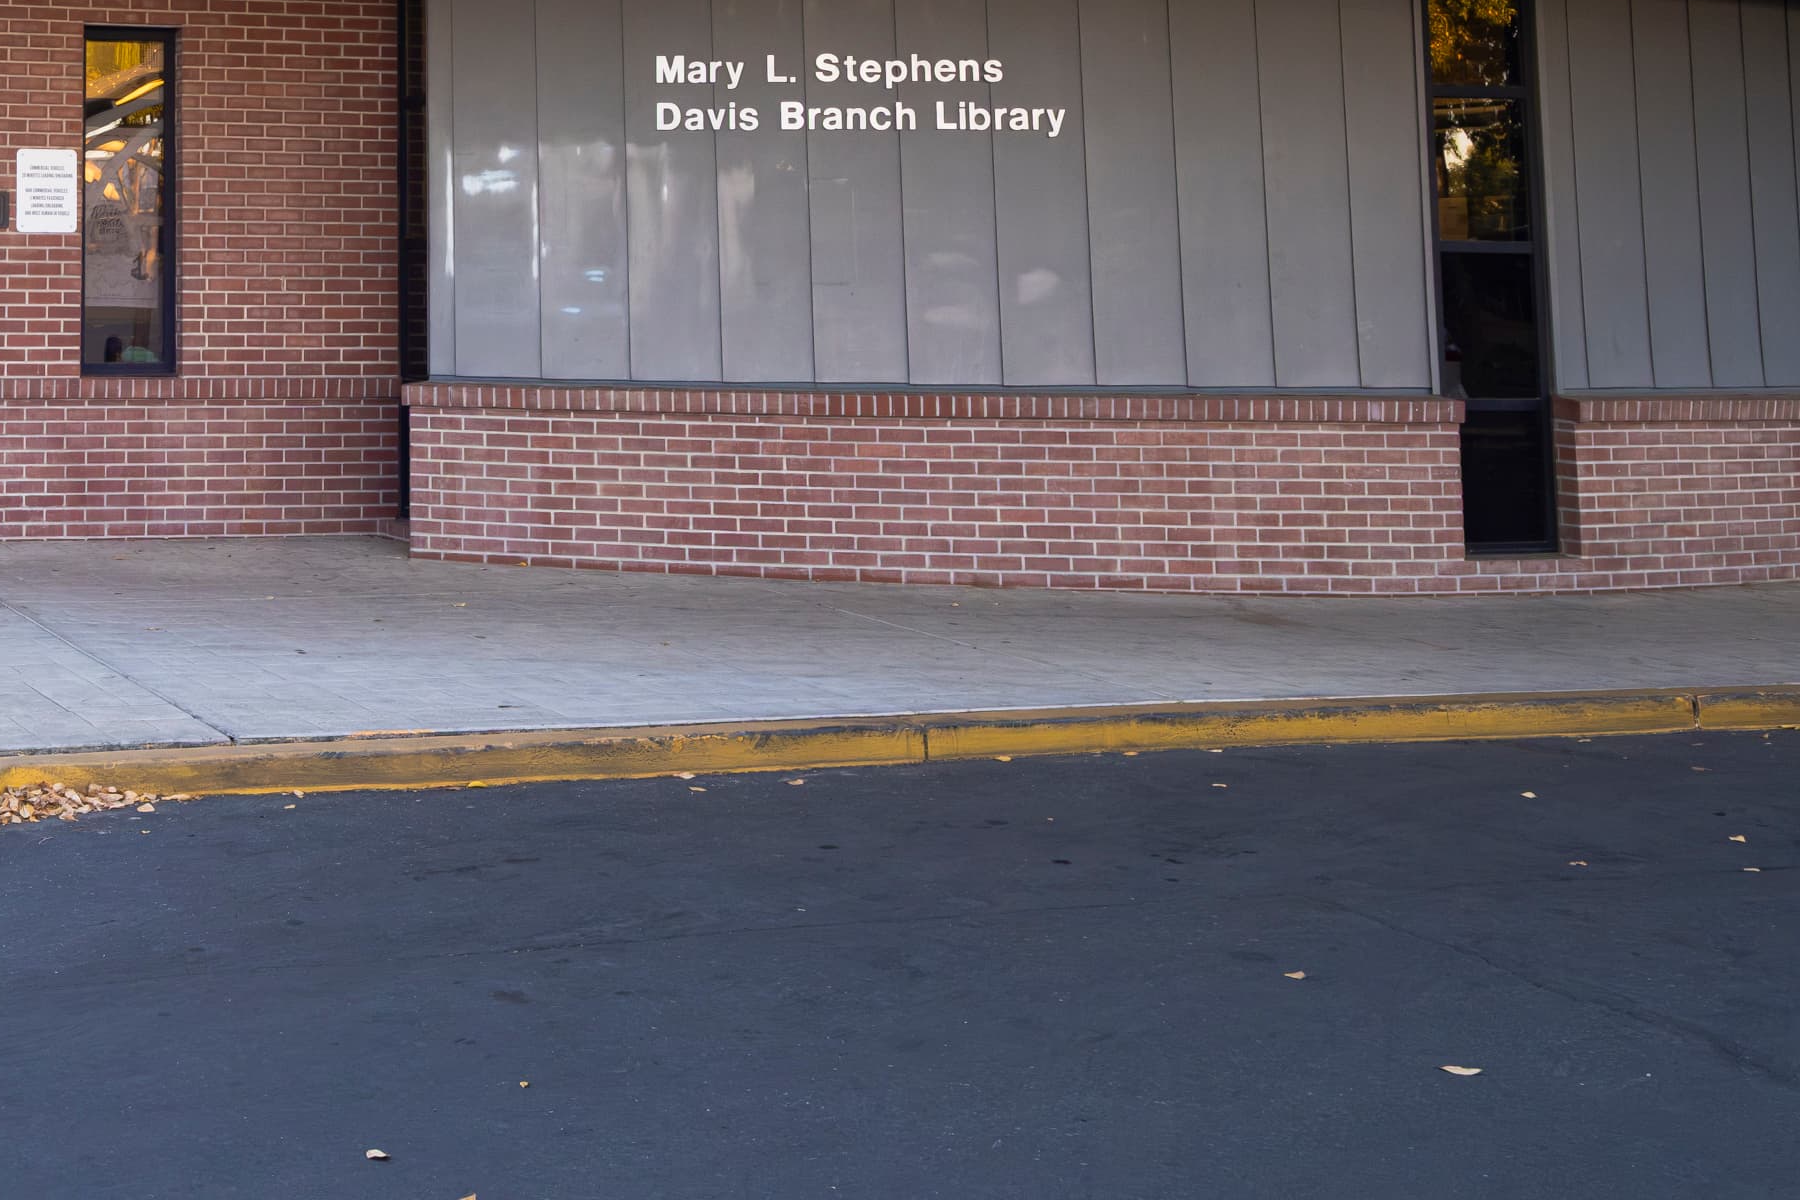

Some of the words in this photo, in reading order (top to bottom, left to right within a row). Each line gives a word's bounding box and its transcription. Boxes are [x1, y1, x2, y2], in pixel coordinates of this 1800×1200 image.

[654, 54, 745, 90] Mary
[766, 54, 798, 84] L.
[815, 53, 1004, 90] Stephens
[655, 101, 760, 132] Davis
[780, 100, 918, 132] Branch
[935, 100, 1066, 138] Library
